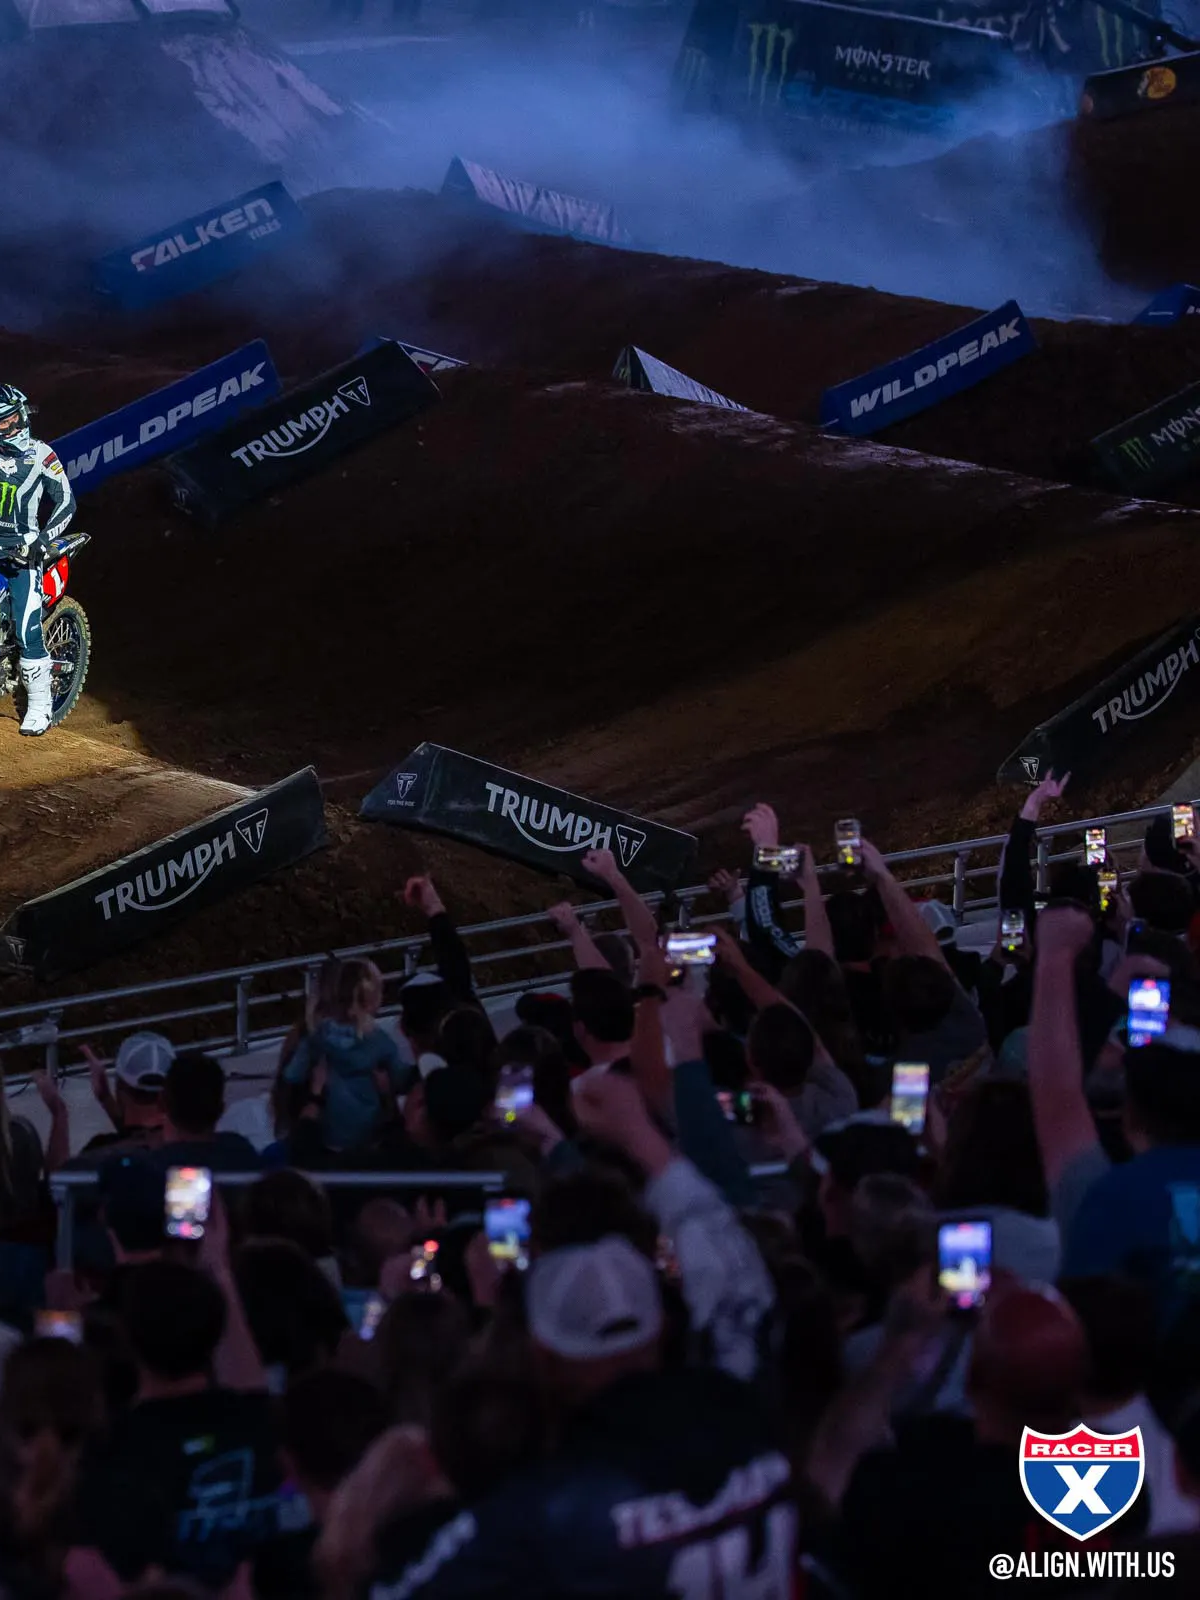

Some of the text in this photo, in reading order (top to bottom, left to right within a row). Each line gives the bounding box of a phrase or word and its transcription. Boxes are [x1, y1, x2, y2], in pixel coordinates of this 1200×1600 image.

[130, 198, 275, 273] FALKEN
[850, 316, 1021, 419] WILDPEAK
[66, 360, 266, 481] WILDPEAK
[230, 394, 350, 468] TRIUMPH
[1091, 638, 1200, 734] TRIUMPH
[485, 781, 613, 852] TRIUMPH
[95, 829, 237, 921] TRIUMPH
